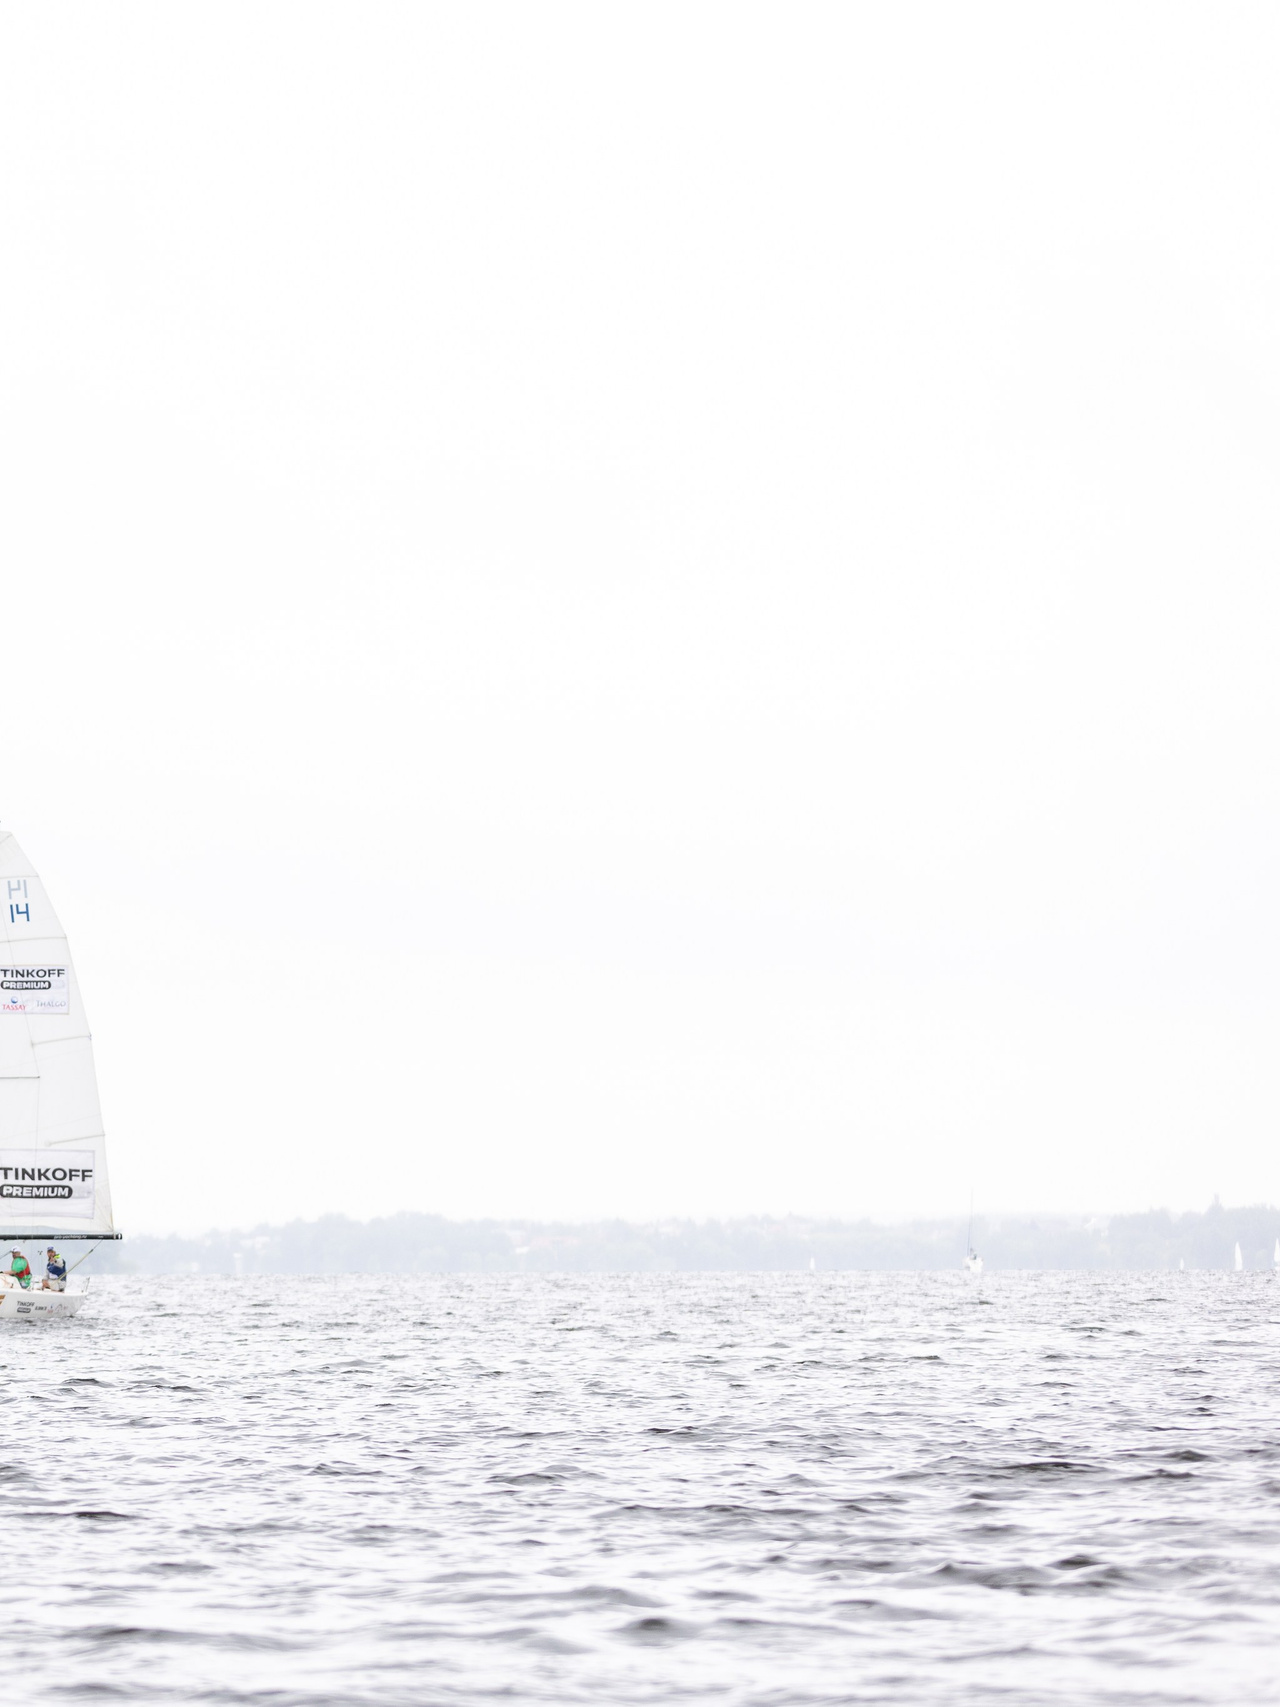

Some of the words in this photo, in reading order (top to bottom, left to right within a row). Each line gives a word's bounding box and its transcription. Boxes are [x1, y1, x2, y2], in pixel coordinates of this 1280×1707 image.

[9, 902, 31, 923] 14
[0, 968, 66, 979] TINKOFF
[2, 981, 49, 990] PREMIUM
[1, 1185, 70, 1198] PREMIUM
